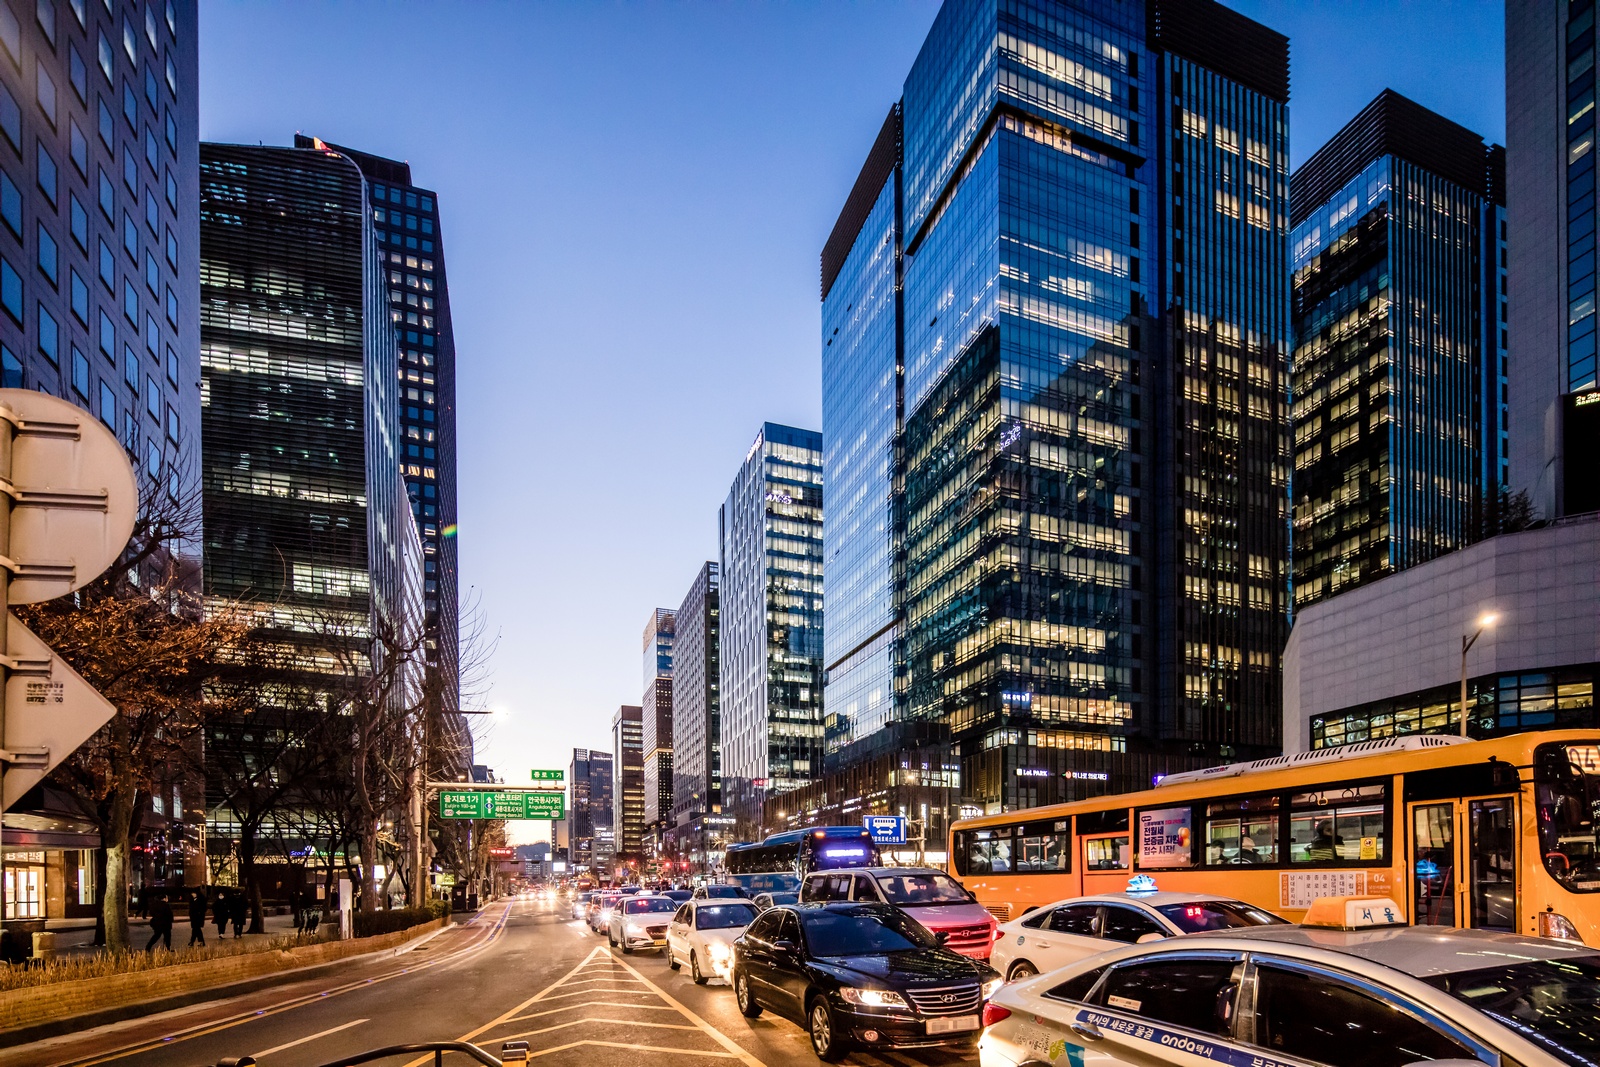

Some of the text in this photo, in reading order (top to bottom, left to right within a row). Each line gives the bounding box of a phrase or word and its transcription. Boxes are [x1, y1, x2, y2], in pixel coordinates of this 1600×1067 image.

[1569, 748, 1596, 771] 04
[1033, 769, 1048, 777] PARK
[444, 794, 479, 804] 을지로1가
[528, 796, 562, 805] 안국동사거리
[1144, 826, 1164, 836] 전월세
[1144, 834, 1179, 846] 보증금 지원
[1144, 845, 1175, 855] 접수 시작!
[1374, 874, 1385, 882] 04
[1363, 907, 1395, 923] 서울
[1087, 1013, 1110, 1027] 택시의
[1110, 1019, 1135, 1034] 새로운
[1135, 1025, 1154, 1040] 물결
